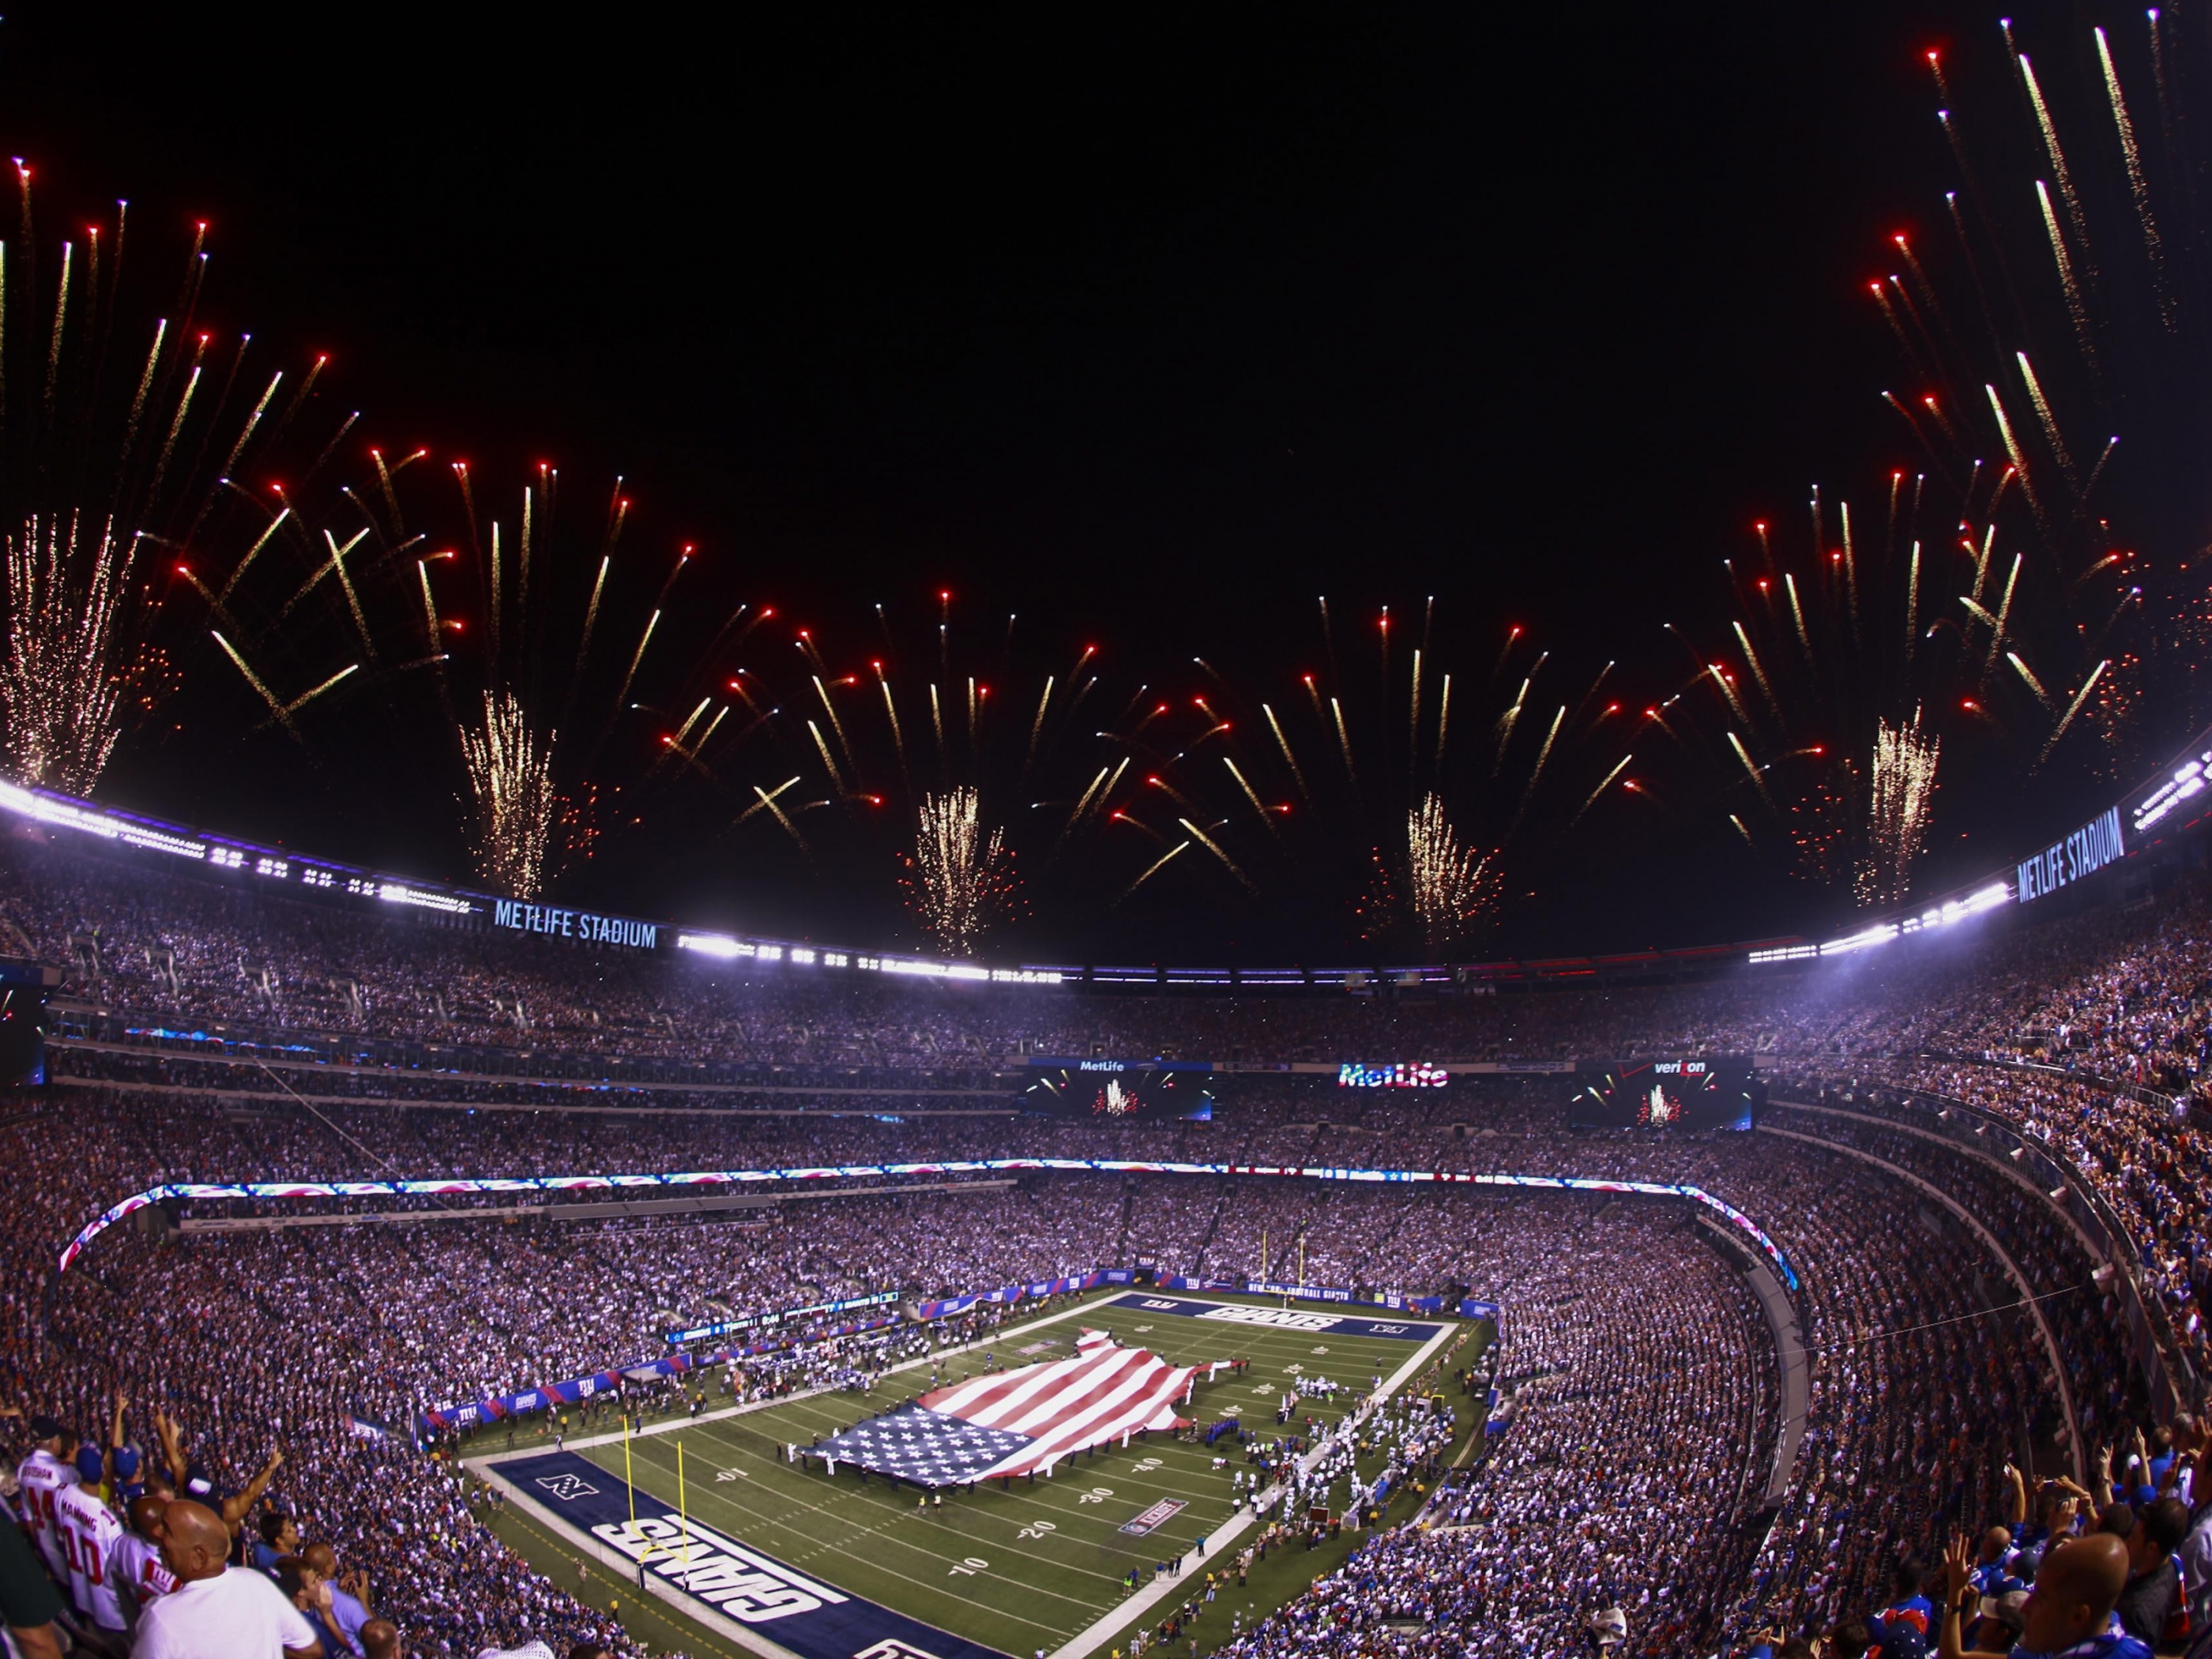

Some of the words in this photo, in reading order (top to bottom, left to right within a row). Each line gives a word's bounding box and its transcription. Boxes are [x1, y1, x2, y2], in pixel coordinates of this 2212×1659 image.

[2017, 842, 2066, 904] METLIFE
[2067, 806, 2124, 882] STADIUM
[494, 899, 572, 938] METLIFE
[579, 914, 656, 949] STADIUM
[1080, 1060, 1125, 1072] MetLife
[1337, 1062, 1449, 1088] MetLife
[1654, 1059, 1706, 1076] verizon
[1198, 1306, 1344, 1330] GIANTS
[1082, 1487, 1115, 1504] 30
[61, 1499, 98, 1533] MANNING
[1022, 1521, 1057, 1539] 20
[64, 1525, 103, 1586] 10
[955, 1557, 989, 1576] 10
[591, 1514, 823, 1623] GIANTS
